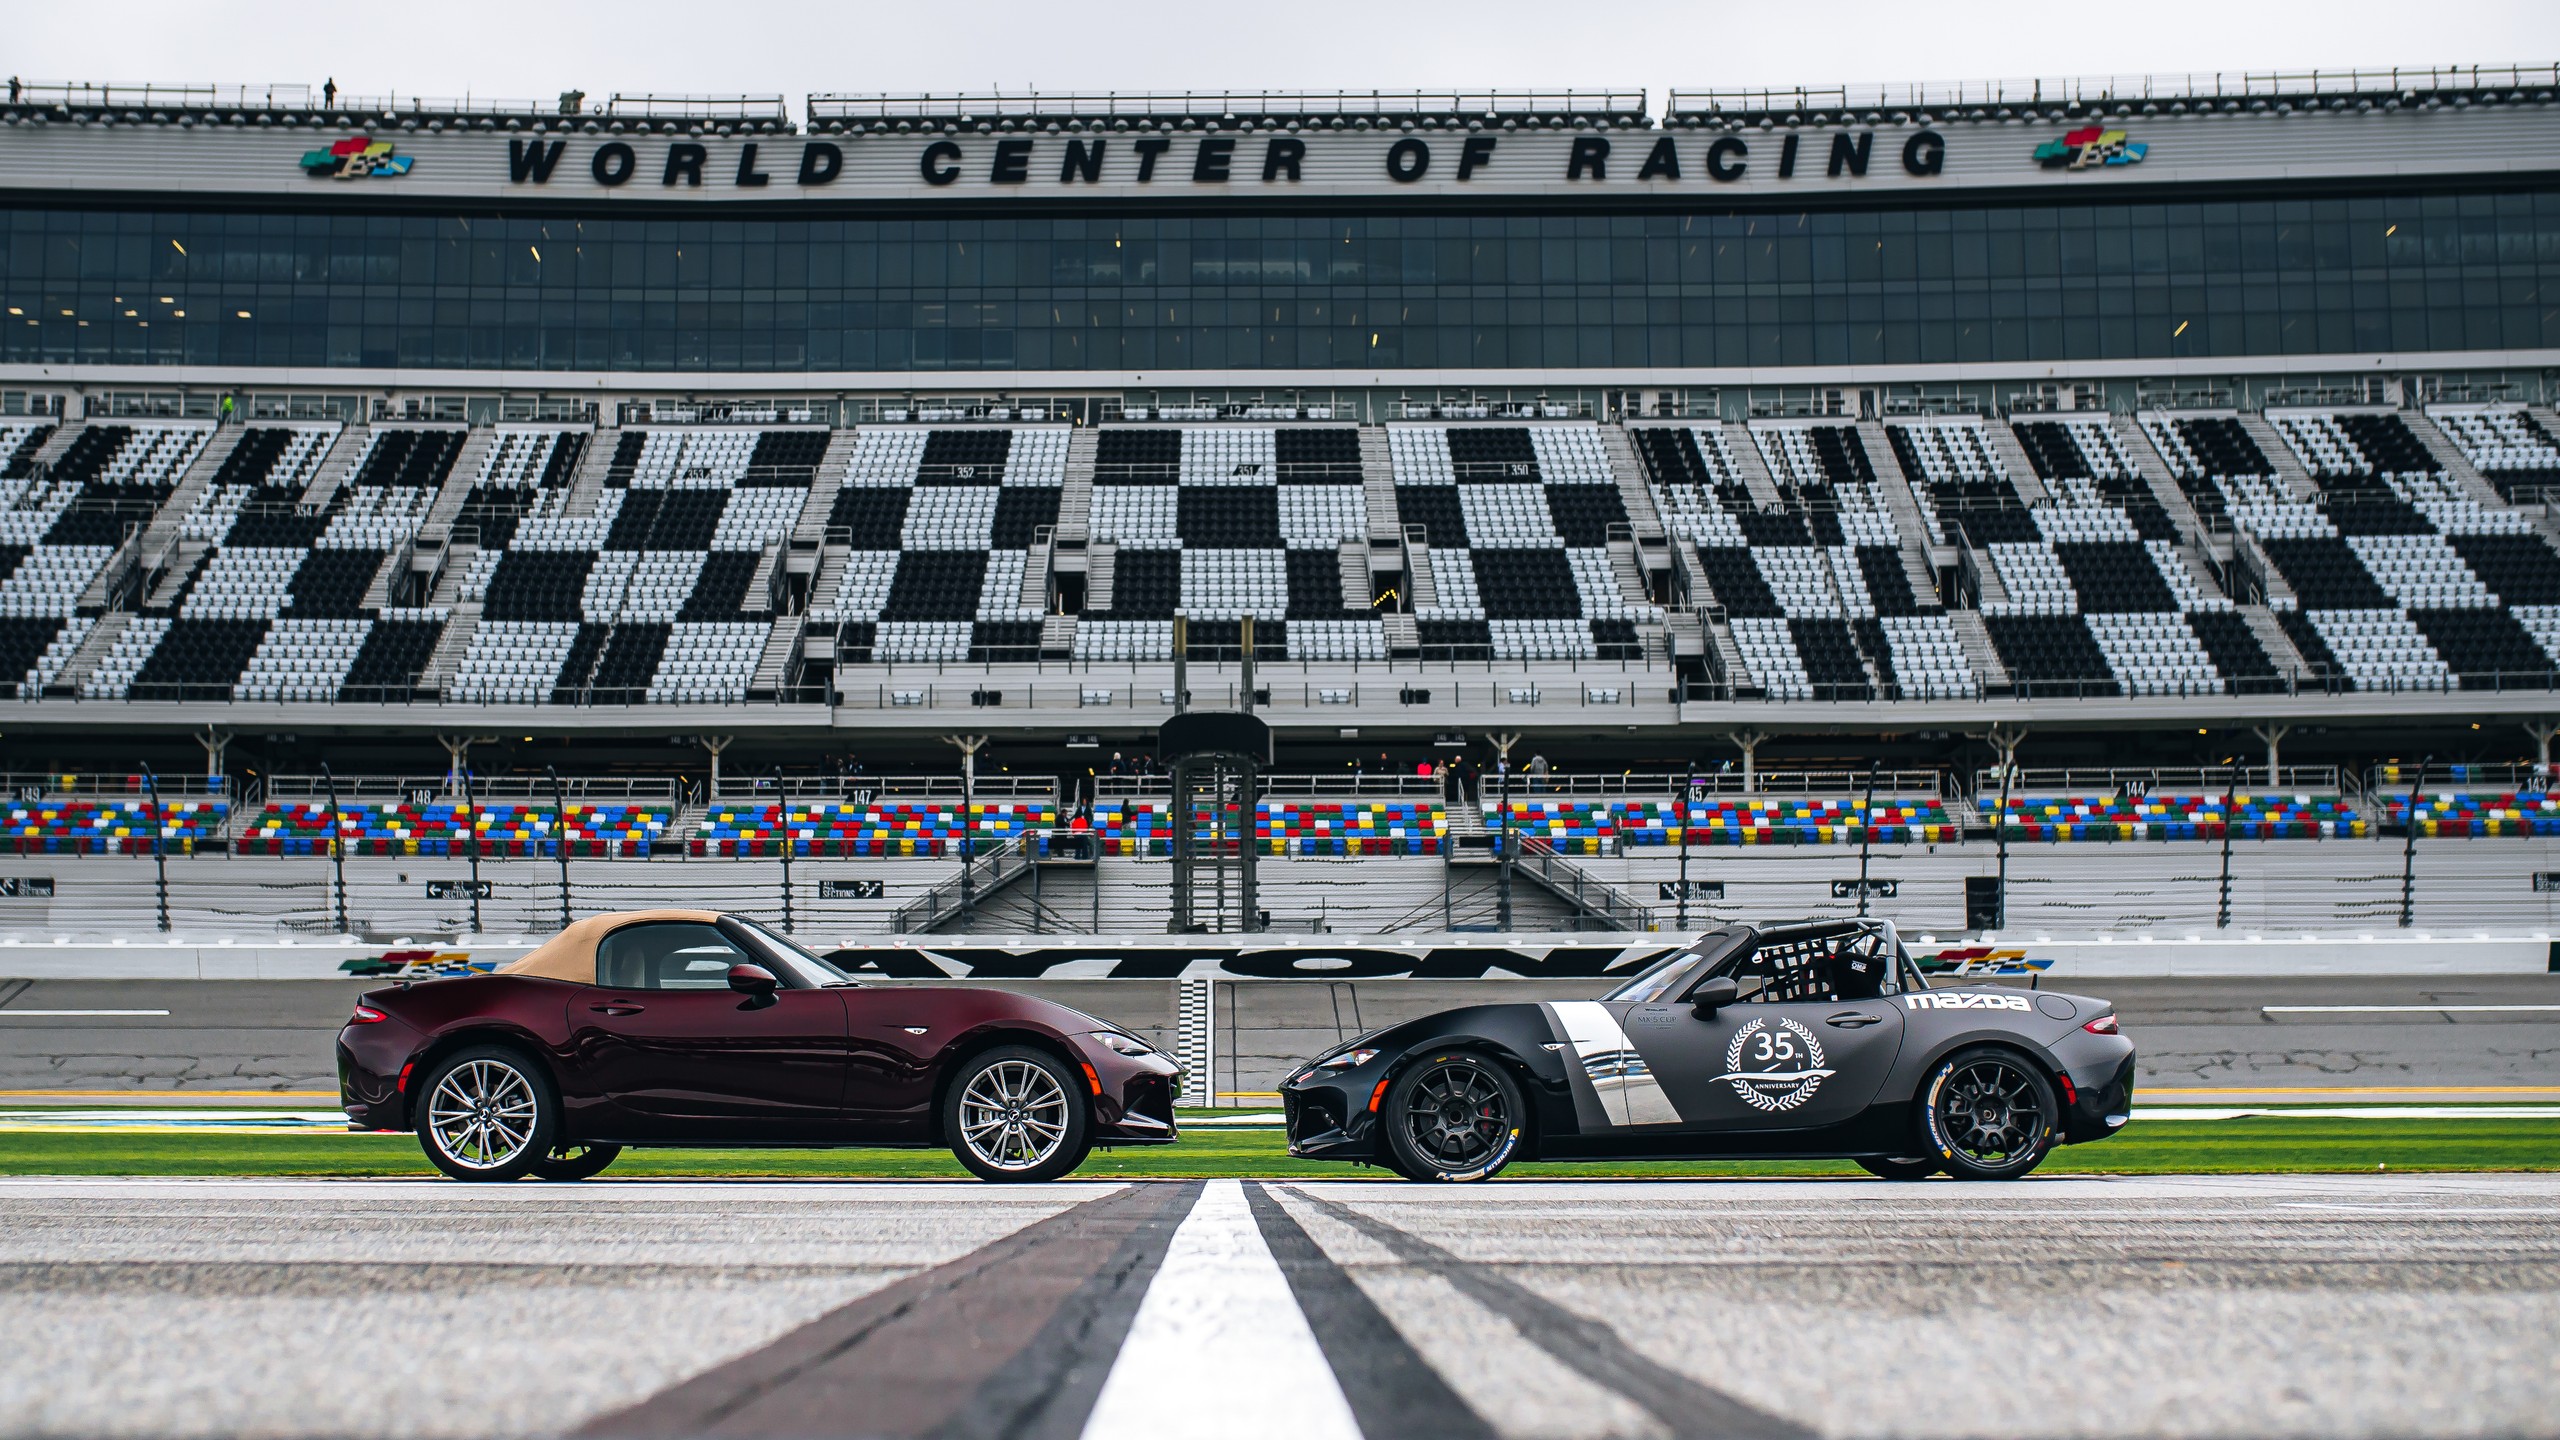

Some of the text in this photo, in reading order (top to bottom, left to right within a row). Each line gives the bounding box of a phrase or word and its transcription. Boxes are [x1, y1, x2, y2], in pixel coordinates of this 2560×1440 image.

[509, 130, 1946, 187] WORLD CENTER OF RACING
[973, 406, 984, 418] L3
[1229, 405, 1241, 417] L2
[688, 469, 704, 479] 353
[957, 467, 974, 479] 352
[1238, 465, 1254, 476] 351
[1511, 464, 1529, 475] 350
[294, 503, 312, 517] 354
[2125, 781, 2145, 797] 144
[2527, 776, 2547, 793] 143
[21, 787, 40, 802] 149
[412, 790, 431, 804] 148
[853, 790, 872, 804] 147
[1685, 787, 1702, 802] 45
[823, 889, 855, 898] SECTIONS
[1486, 1141, 1514, 1172] MICHELIN
